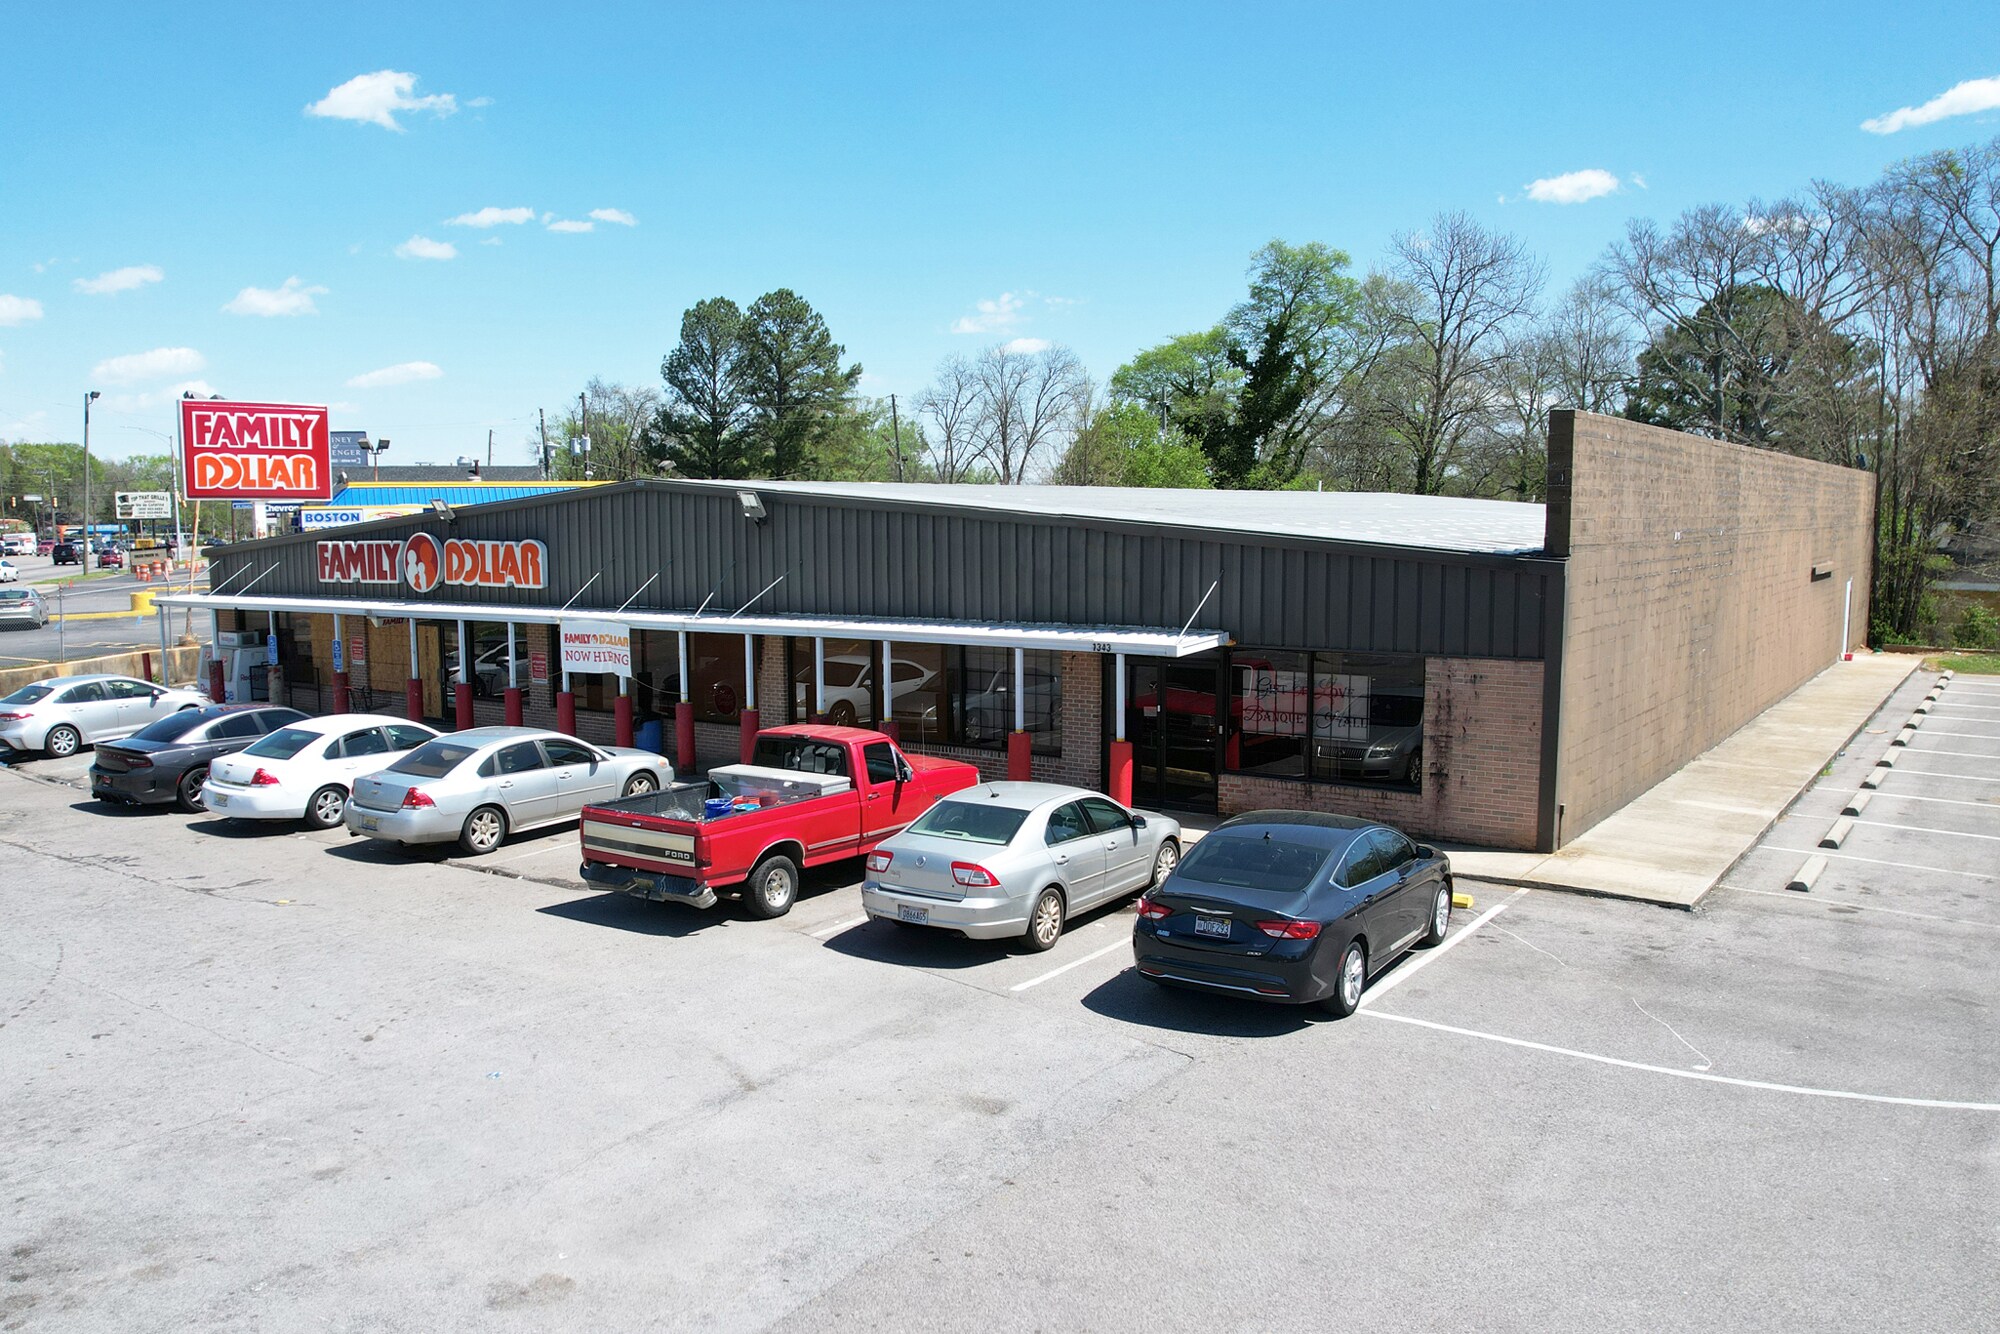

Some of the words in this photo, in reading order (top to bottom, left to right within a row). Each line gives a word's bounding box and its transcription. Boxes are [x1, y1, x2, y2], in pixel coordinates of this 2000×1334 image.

[193, 412, 319, 449] FAMILY
[194, 452, 317, 490] DOLLAR
[265, 504, 300, 512] Chevron
[305, 512, 360, 523] BOSTON
[317, 542, 403, 582] FAMILY
[444, 540, 543, 587] DOLLAR
[564, 633, 591, 645] FAMILY
[599, 633, 629, 648] DOLLAR
[1092, 642, 1112, 653] 1343
[565, 650, 591, 662] NOW
[594, 651, 629, 666] HIRNG
[1243, 705, 1308, 724] BANQUE
[665, 850, 690, 859] FORD
